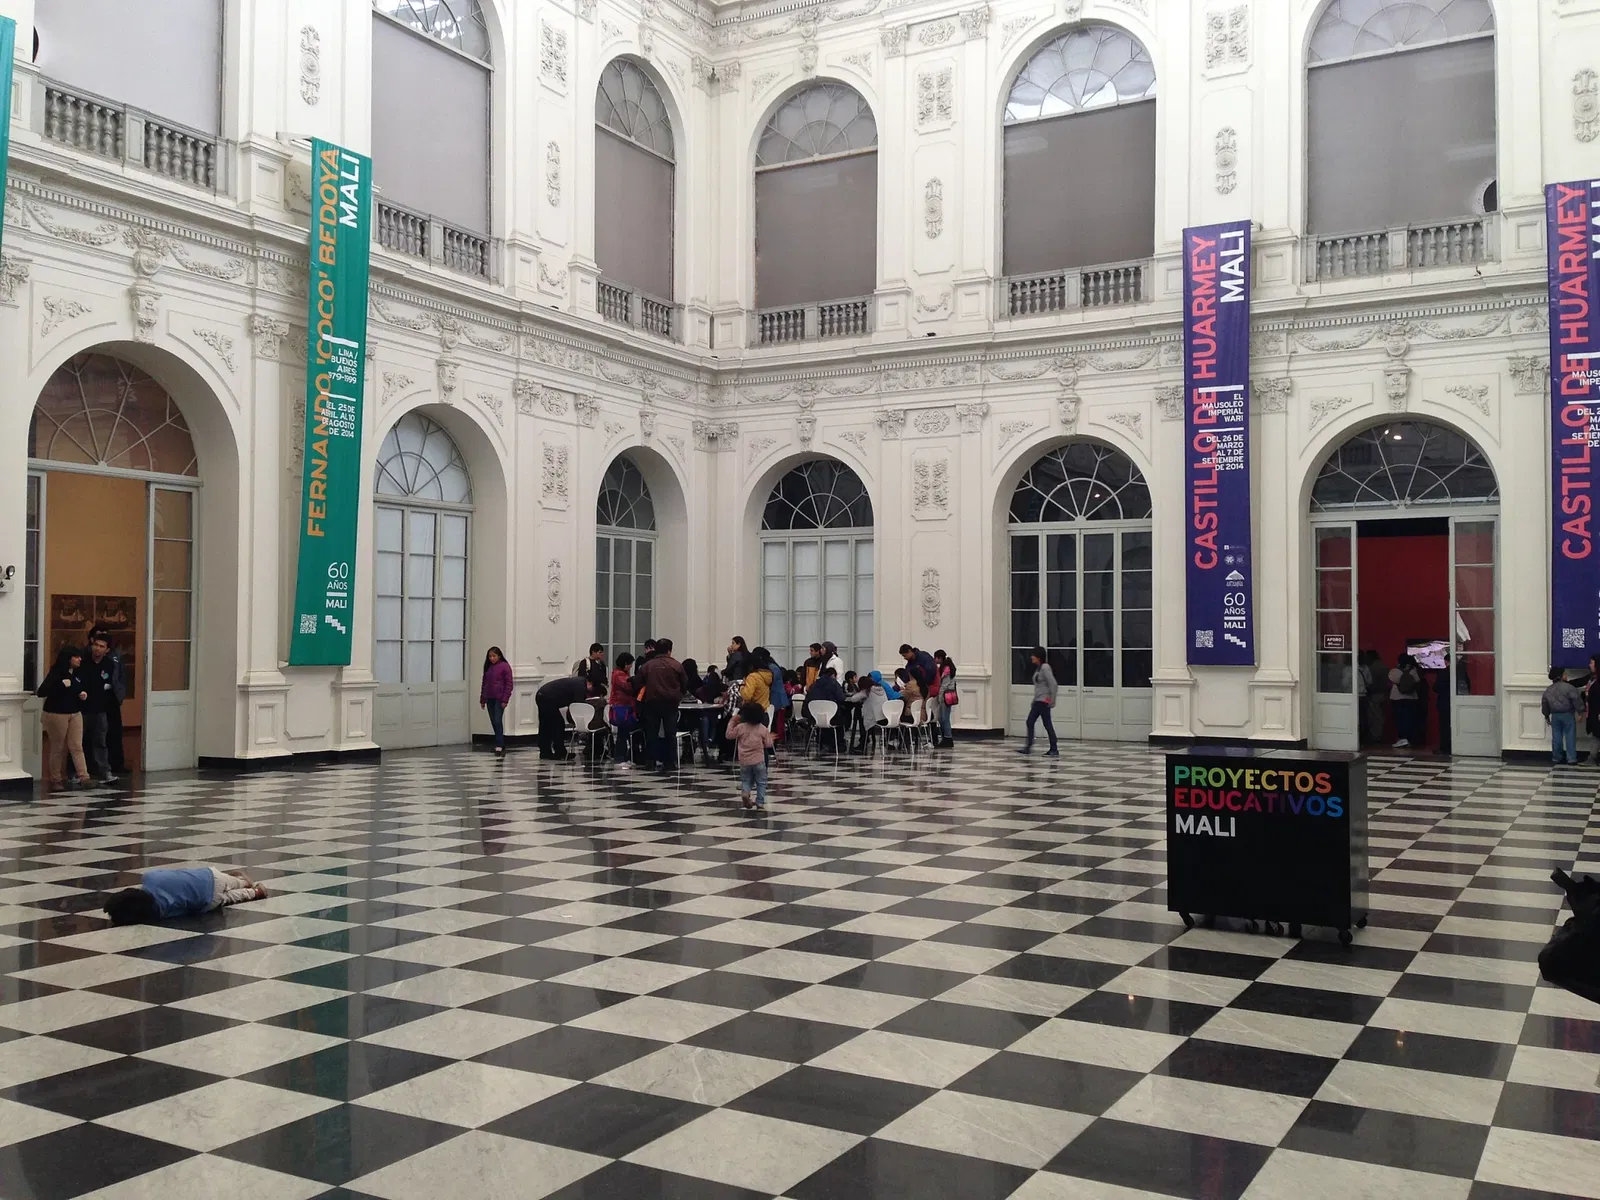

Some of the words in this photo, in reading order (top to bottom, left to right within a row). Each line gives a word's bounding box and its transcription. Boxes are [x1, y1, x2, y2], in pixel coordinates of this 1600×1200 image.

[340, 152, 360, 228] MALI
[318, 149, 340, 266] BEDOYA
[1220, 230, 1244, 302] MALI
[1556, 184, 1588, 344] HUARMEY
[1192, 236, 1216, 380] HUARMEY
[1560, 354, 1590, 395] DE
[338, 403, 348, 412] 25
[347, 405, 356, 414] DE
[1193, 388, 1216, 424] DE
[1202, 400, 1244, 410] MAUSOLEO
[1208, 408, 1244, 416] IMPERIAL
[328, 418, 355, 430] AGOSTO
[328, 428, 340, 436] DE
[340, 430, 354, 438] 2014
[1217, 442, 1244, 450] MARZO
[1588, 440, 1600, 448] DE
[307, 373, 332, 537] FERNANDO
[1202, 456, 1244, 464] SETIEMBRE
[1560, 404, 1591, 560] CASTILLO
[1194, 432, 1218, 570] CASTILLO
[327, 562, 348, 579] 60
[326, 580, 348, 590] AÑOS
[326, 599, 347, 608] MALI
[1224, 592, 1246, 606] 60
[1224, 606, 1246, 615] AÑOS
[1174, 766, 1332, 794] PROYECTOS
[1174, 788, 1344, 818] EDUCATIVOS
[1175, 814, 1236, 838] MALI
